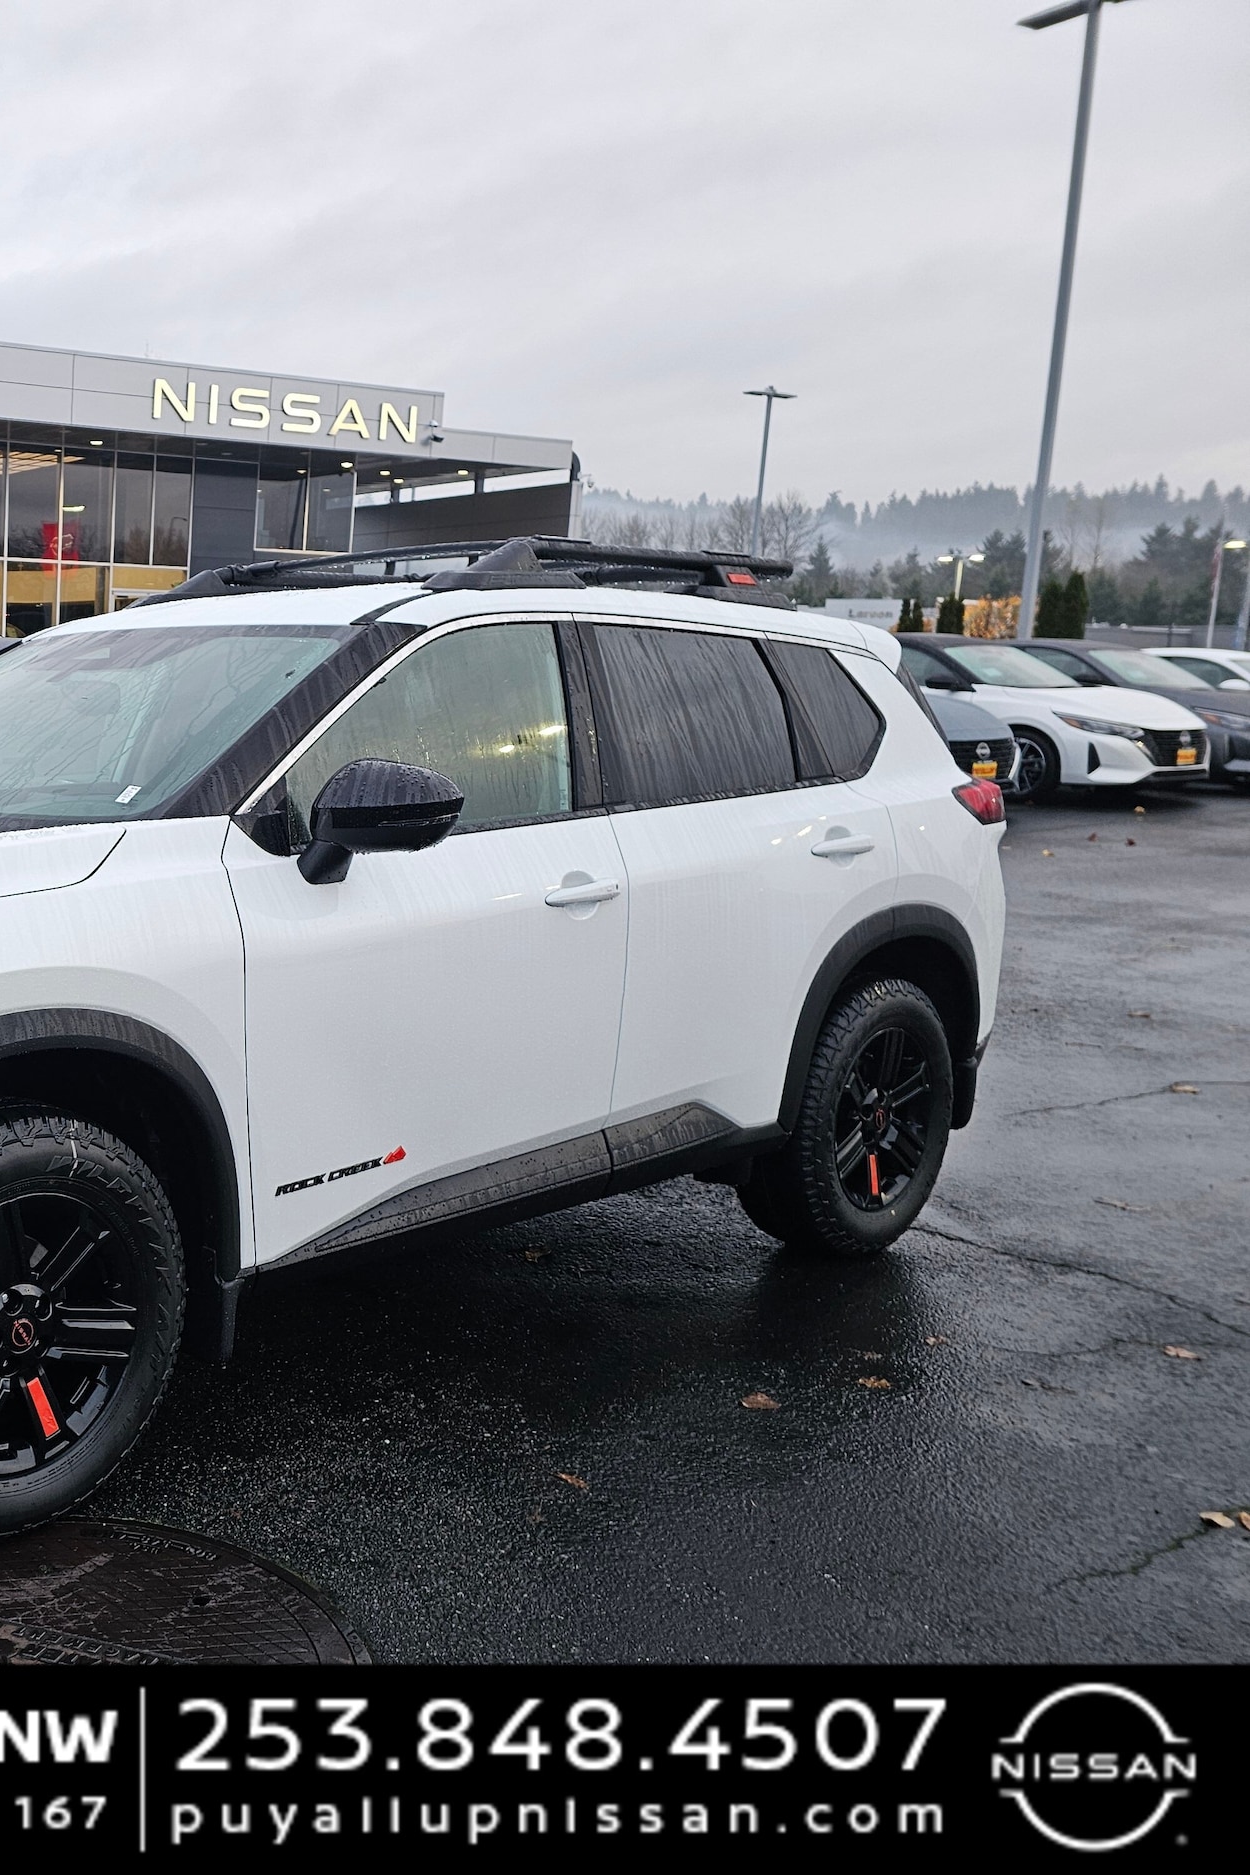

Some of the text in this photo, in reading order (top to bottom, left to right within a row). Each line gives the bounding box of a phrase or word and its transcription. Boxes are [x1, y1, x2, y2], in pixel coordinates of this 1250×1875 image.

[152, 378, 418, 444] NISSAN
[275, 1156, 384, 1197] ROCK CREEK
